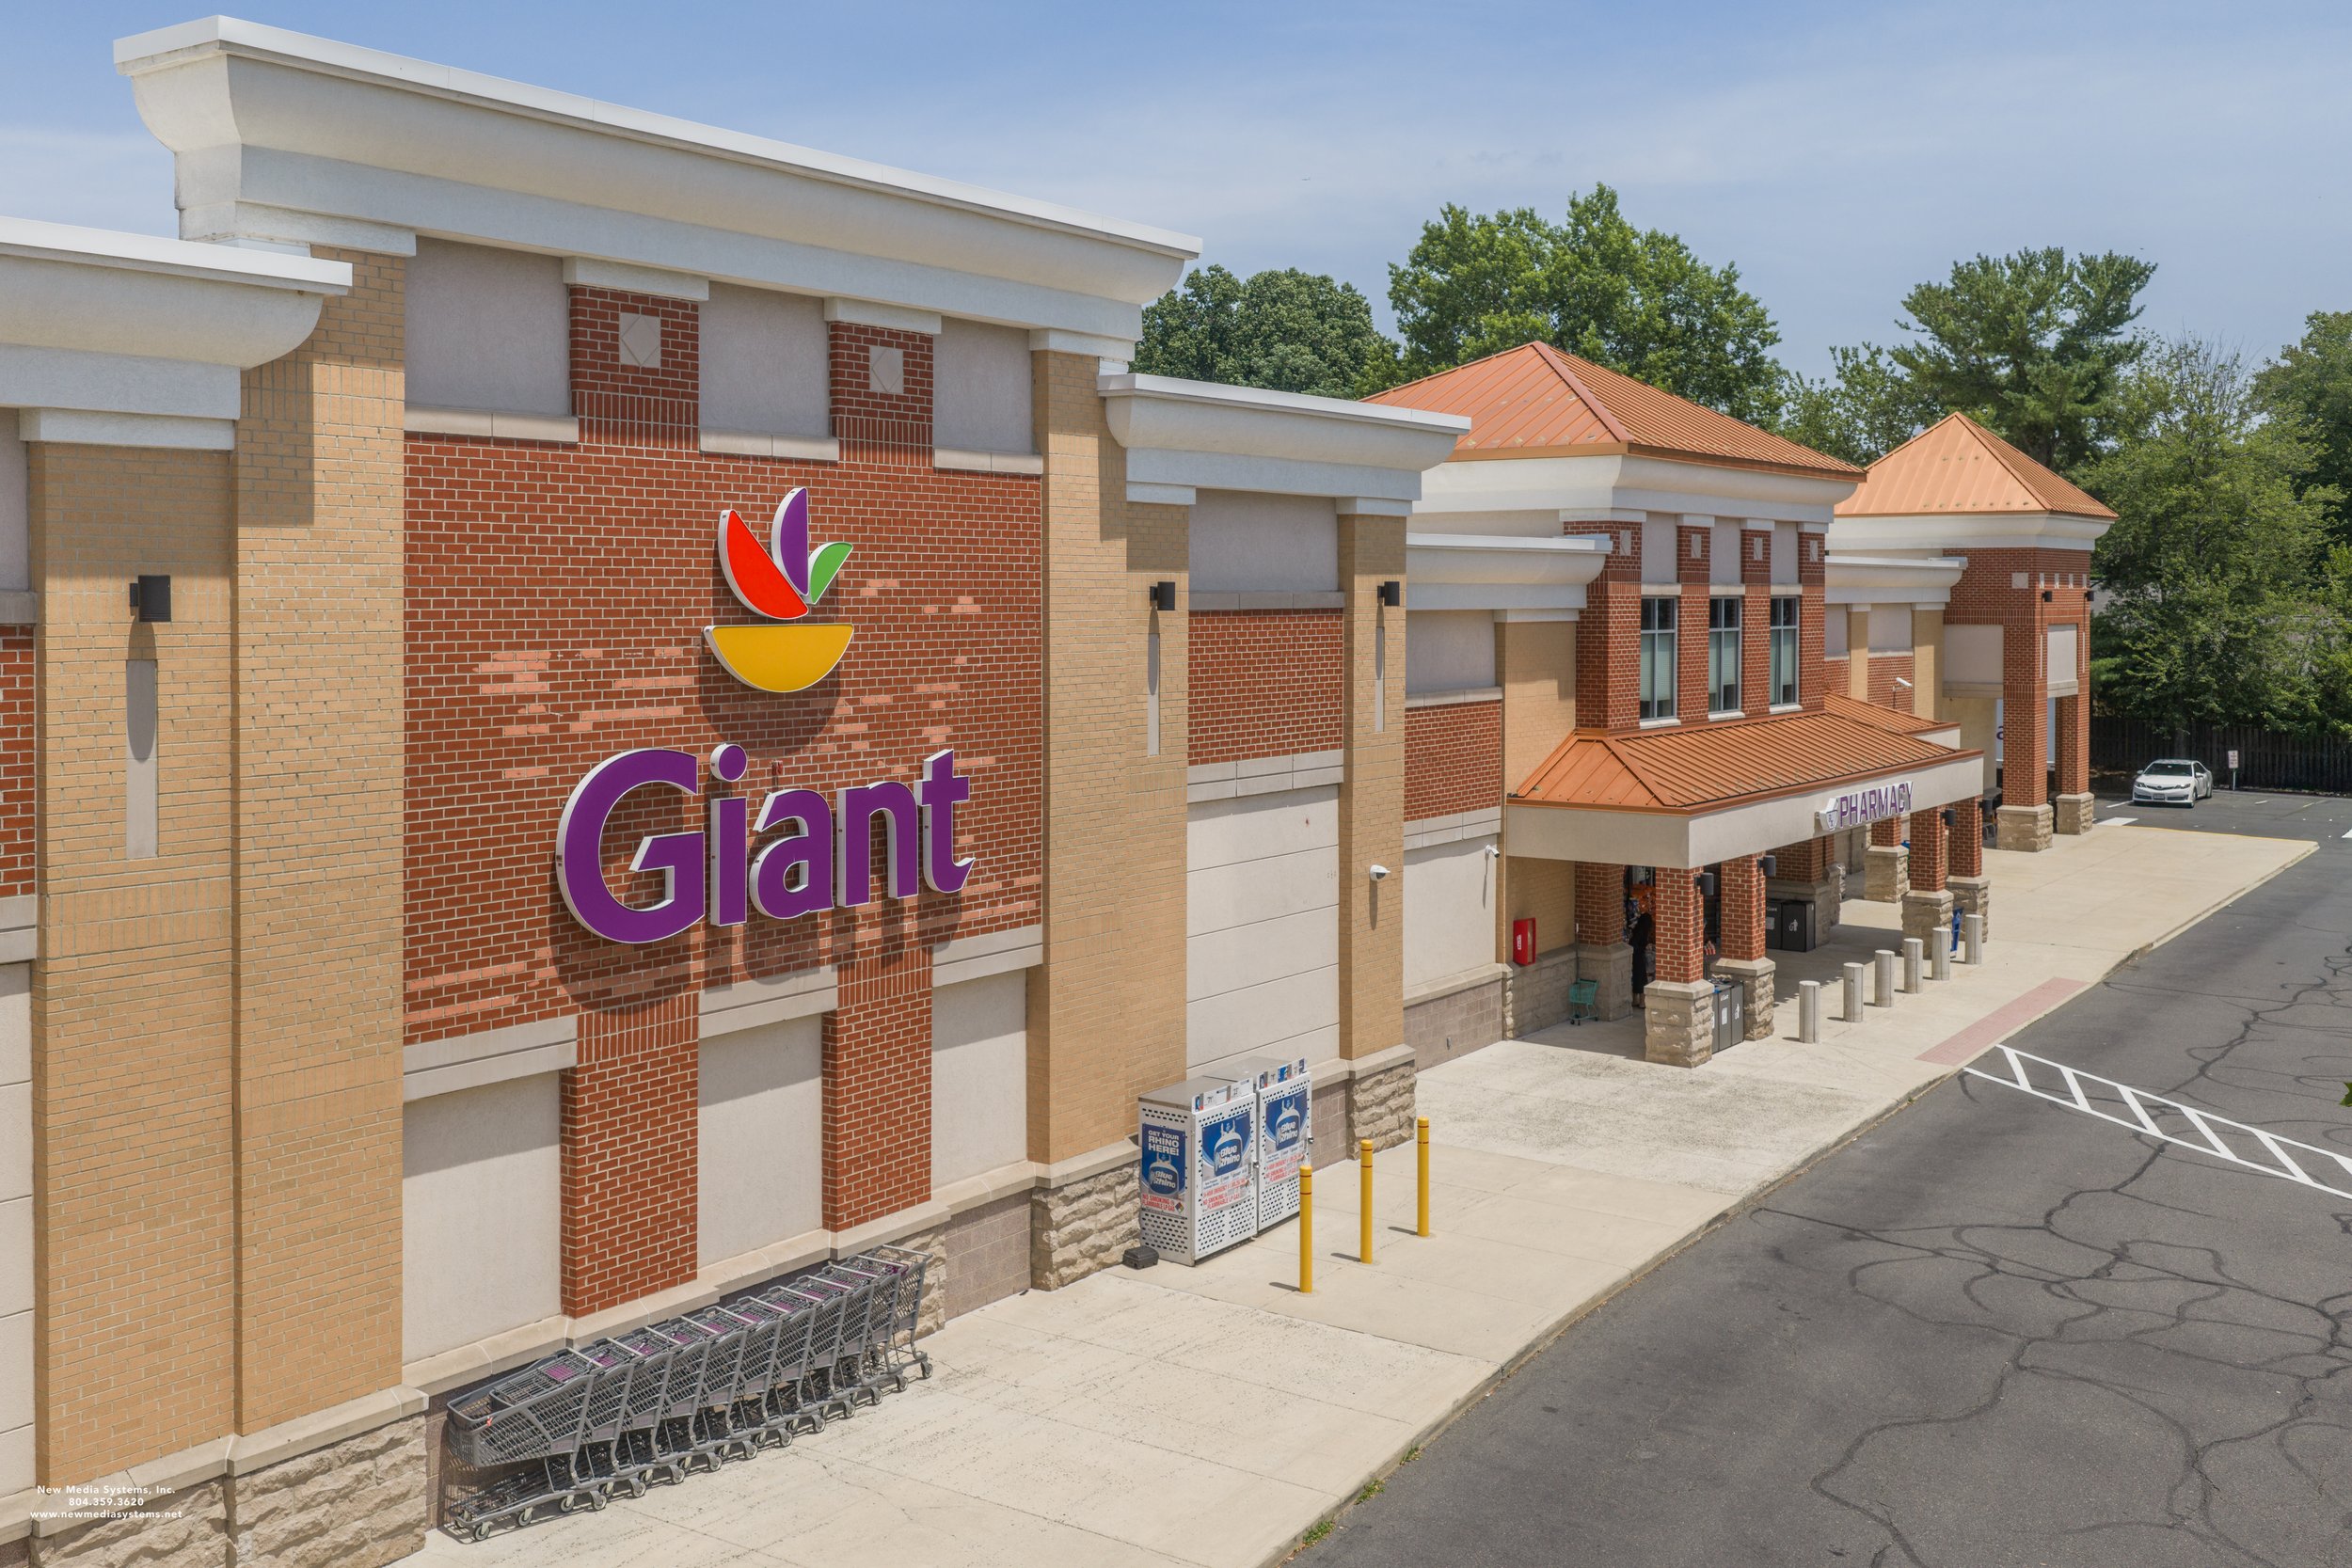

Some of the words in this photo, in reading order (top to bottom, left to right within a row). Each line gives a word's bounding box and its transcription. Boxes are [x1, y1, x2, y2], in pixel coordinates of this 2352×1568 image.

[1839, 782, 1914, 828] PHARMACY
[556, 743, 976, 943] Giant
[1148, 1135, 1180, 1148] RHINO
[1148, 1143, 1180, 1156] HERE!
[1221, 1145, 1238, 1158] Blue
[1155, 1170, 1173, 1180] Blue
[1153, 1177, 1176, 1188] Rhino
